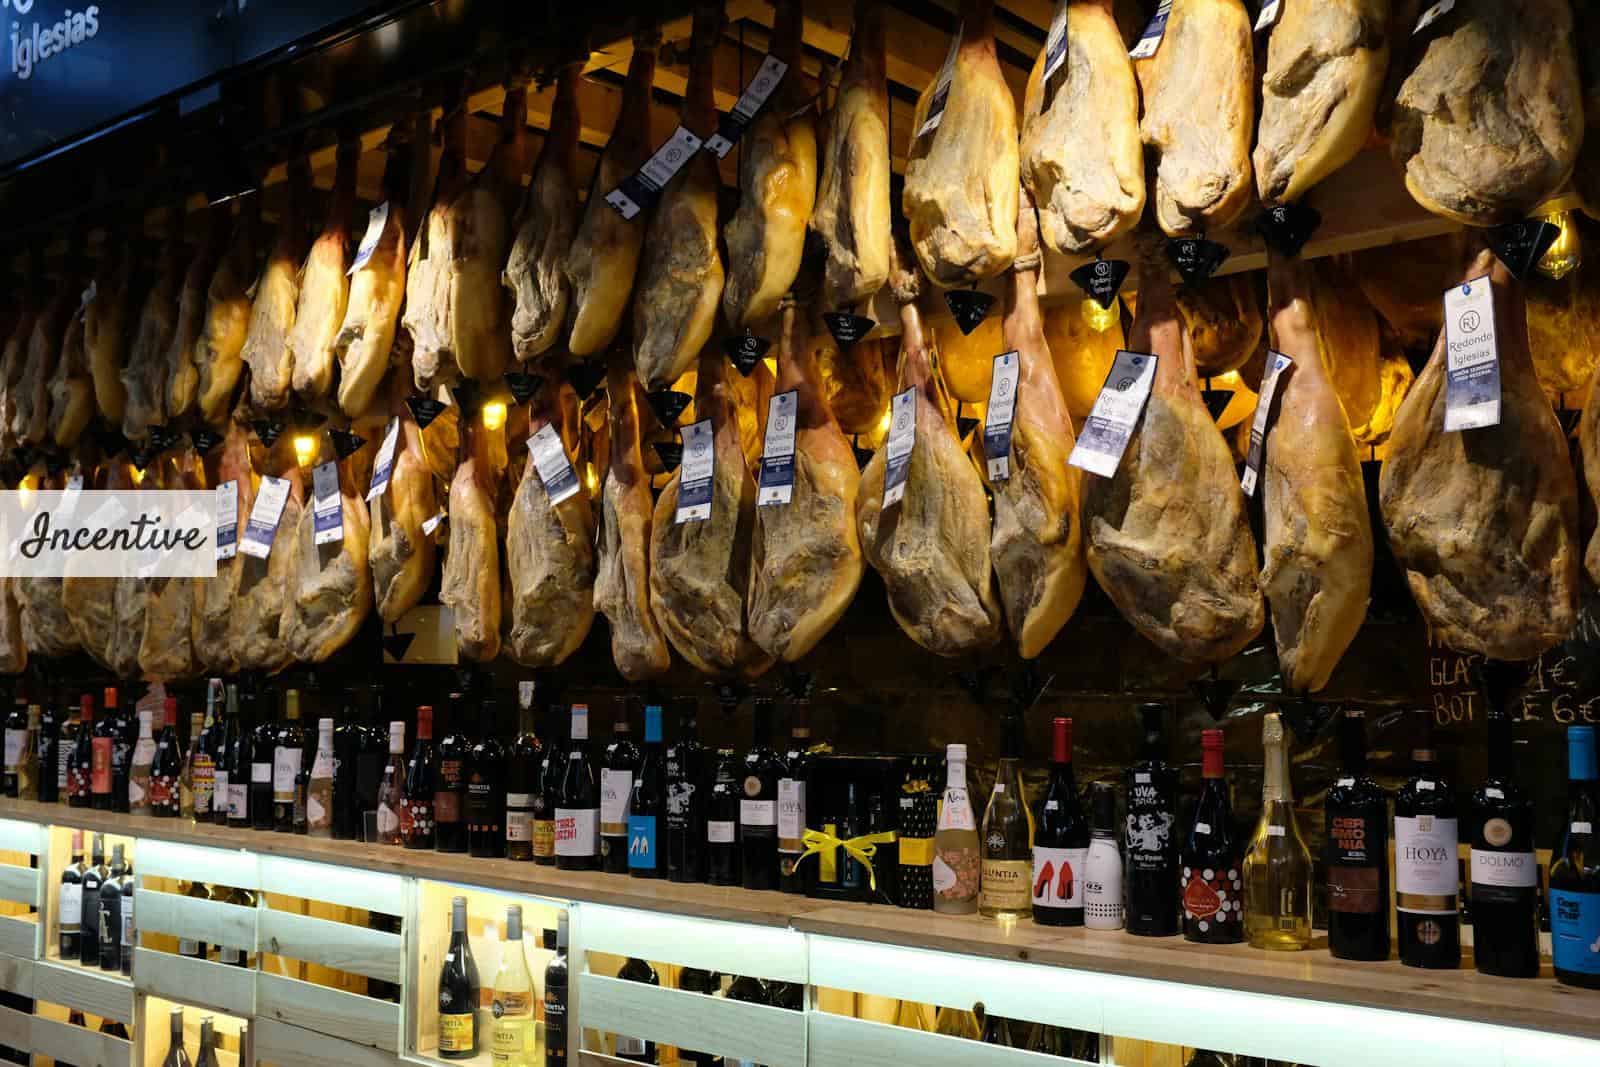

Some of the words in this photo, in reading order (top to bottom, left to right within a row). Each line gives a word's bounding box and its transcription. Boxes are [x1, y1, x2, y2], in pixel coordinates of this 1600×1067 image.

[11, 5, 99, 79] iglesias
[1449, 332, 1492, 352] Redondo
[1454, 350, 1490, 367] Iglesias
[1337, 840, 1366, 849] NIA
[1404, 847, 1449, 862] HOYA
[1479, 855, 1524, 868] DOLMO
